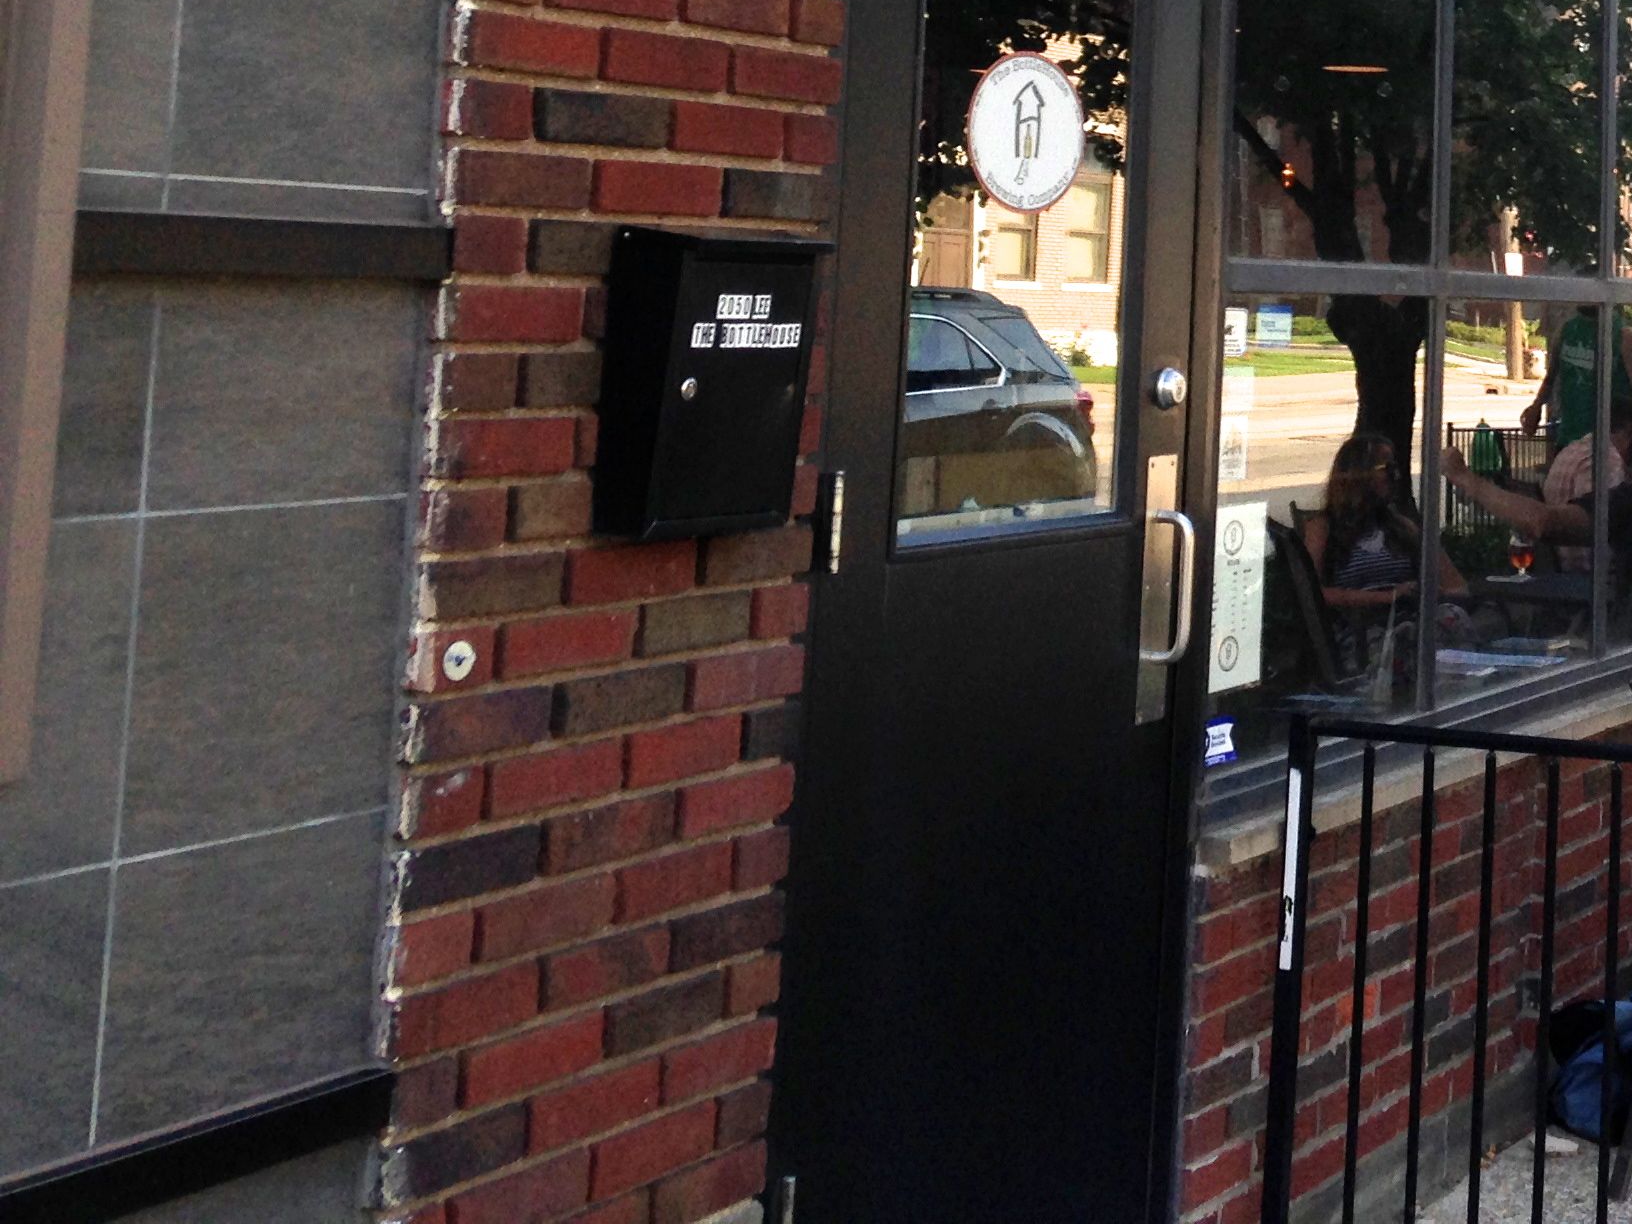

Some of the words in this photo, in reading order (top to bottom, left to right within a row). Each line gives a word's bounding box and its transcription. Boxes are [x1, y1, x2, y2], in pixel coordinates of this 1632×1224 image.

[718, 295, 752, 316] 2050
[752, 295, 771, 316] LEE
[693, 324, 716, 345] THE
[720, 324, 800, 345] BOTTLEHOUSE
